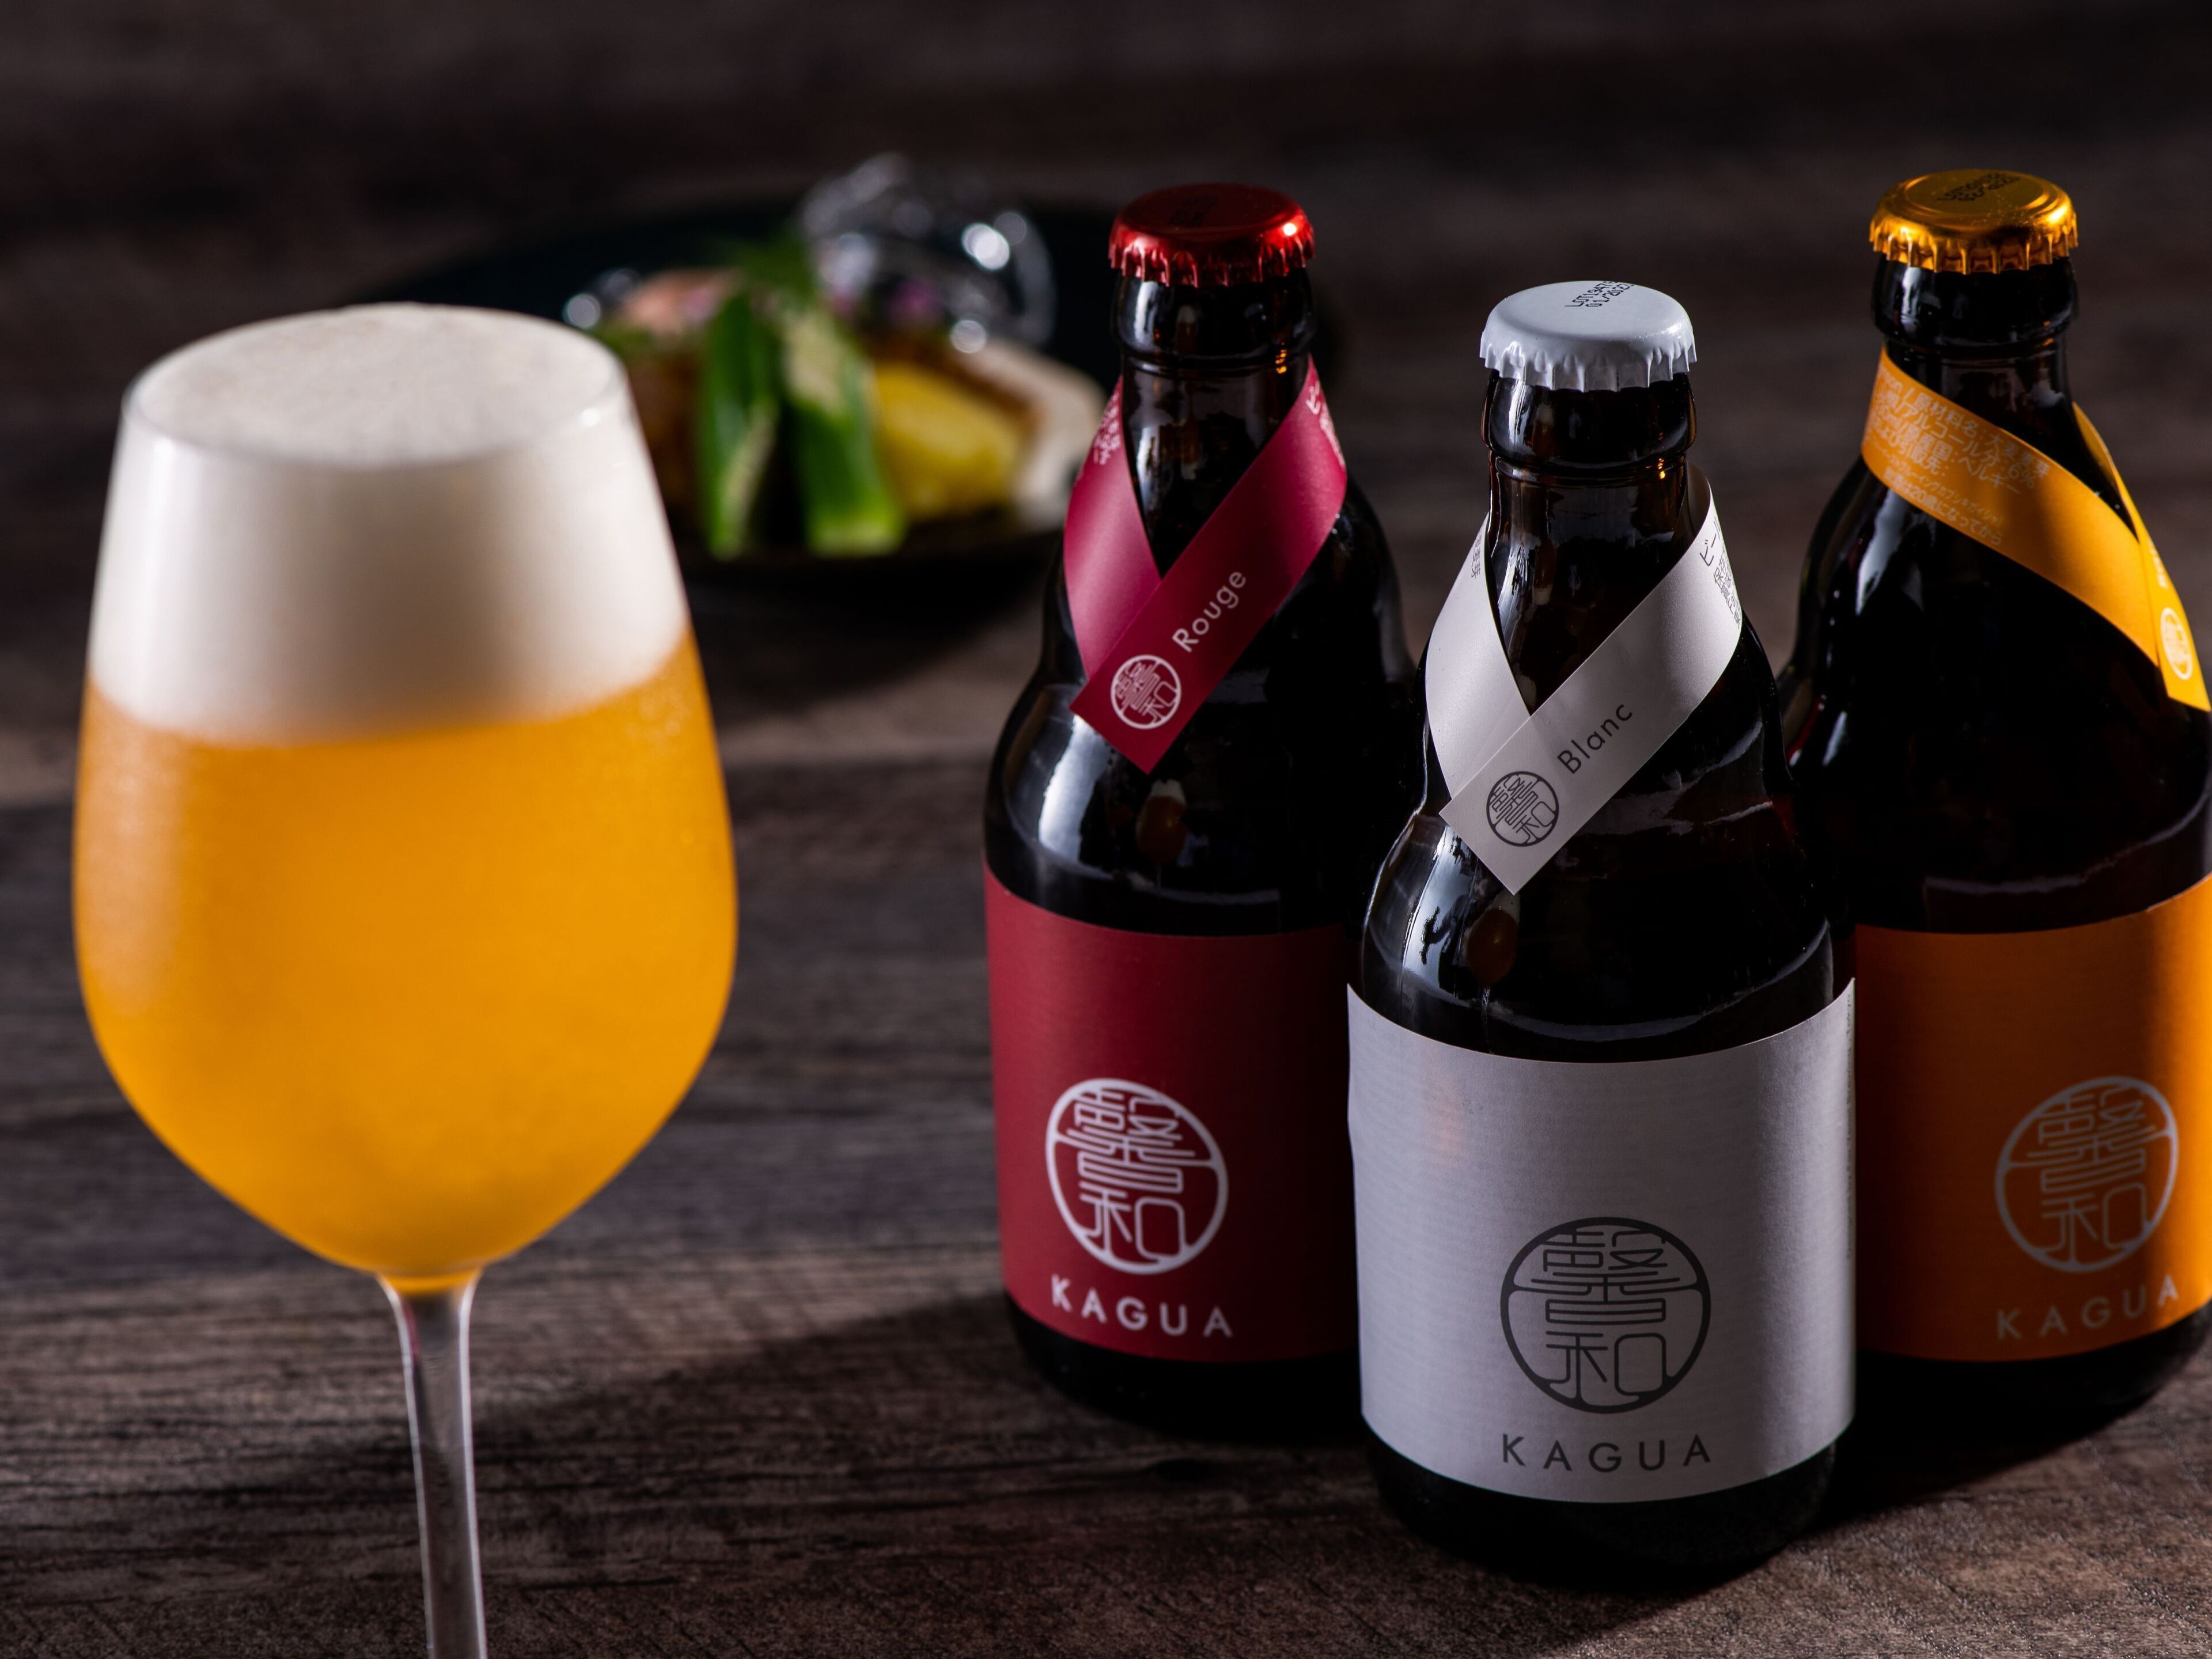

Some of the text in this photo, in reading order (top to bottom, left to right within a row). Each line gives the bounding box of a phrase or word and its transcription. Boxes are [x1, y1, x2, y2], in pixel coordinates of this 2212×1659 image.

[1172, 571, 1246, 653] Rouge
[1557, 704, 1633, 774] Blanc
[1051, 1274, 1233, 1338] KAGUA
[1998, 1275, 2180, 1340] KAGUA
[1502, 1433, 1711, 1472] KAGUA
